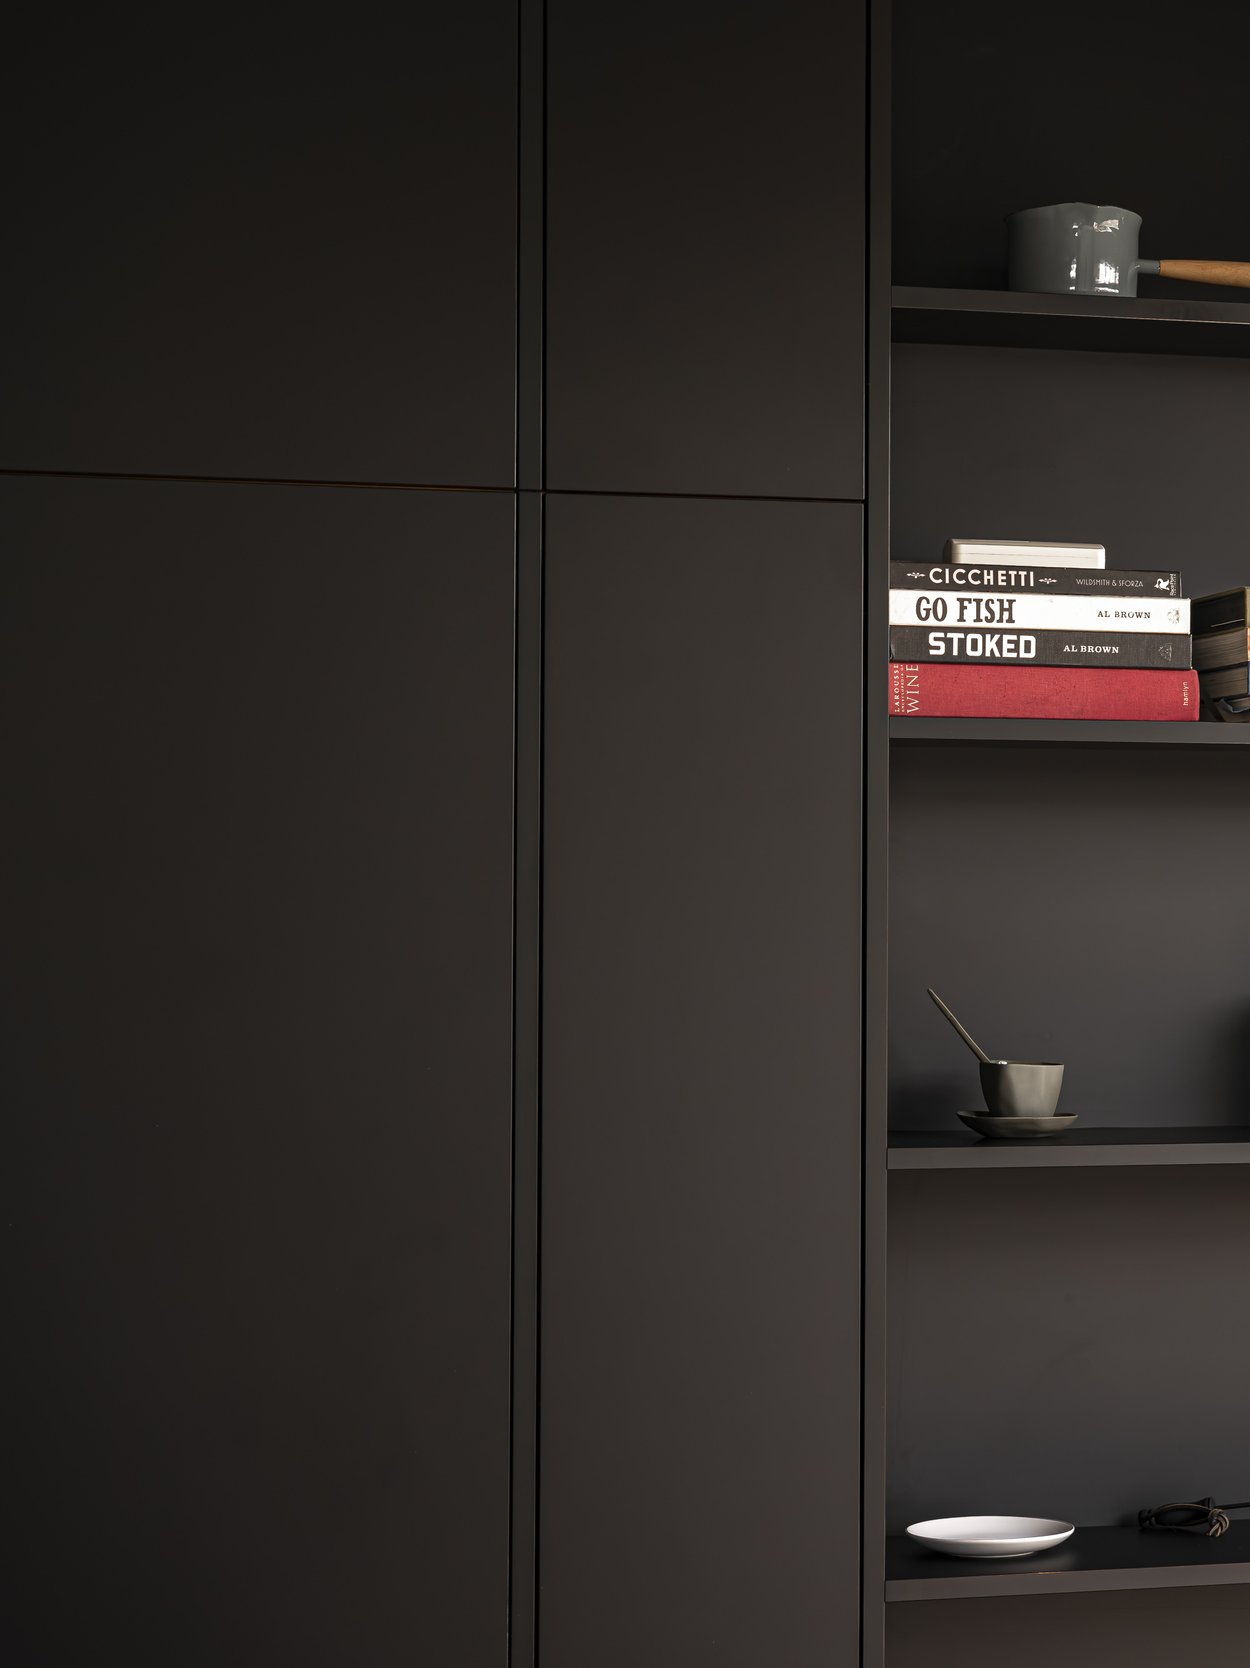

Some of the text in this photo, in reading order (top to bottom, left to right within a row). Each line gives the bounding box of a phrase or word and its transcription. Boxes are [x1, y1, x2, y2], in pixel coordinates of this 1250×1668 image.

[929, 568, 1034, 587] CICCHETTI
[1076, 578, 1110, 586] WILDSMITH
[1118, 579, 1143, 587] SFORZA
[916, 596, 1016, 623] GO FISH
[1114, 611, 1151, 619] BROWN
[928, 632, 1036, 658] STOKED
[1081, 645, 1119, 654] BROWN
[905, 664, 918, 713] WINE
